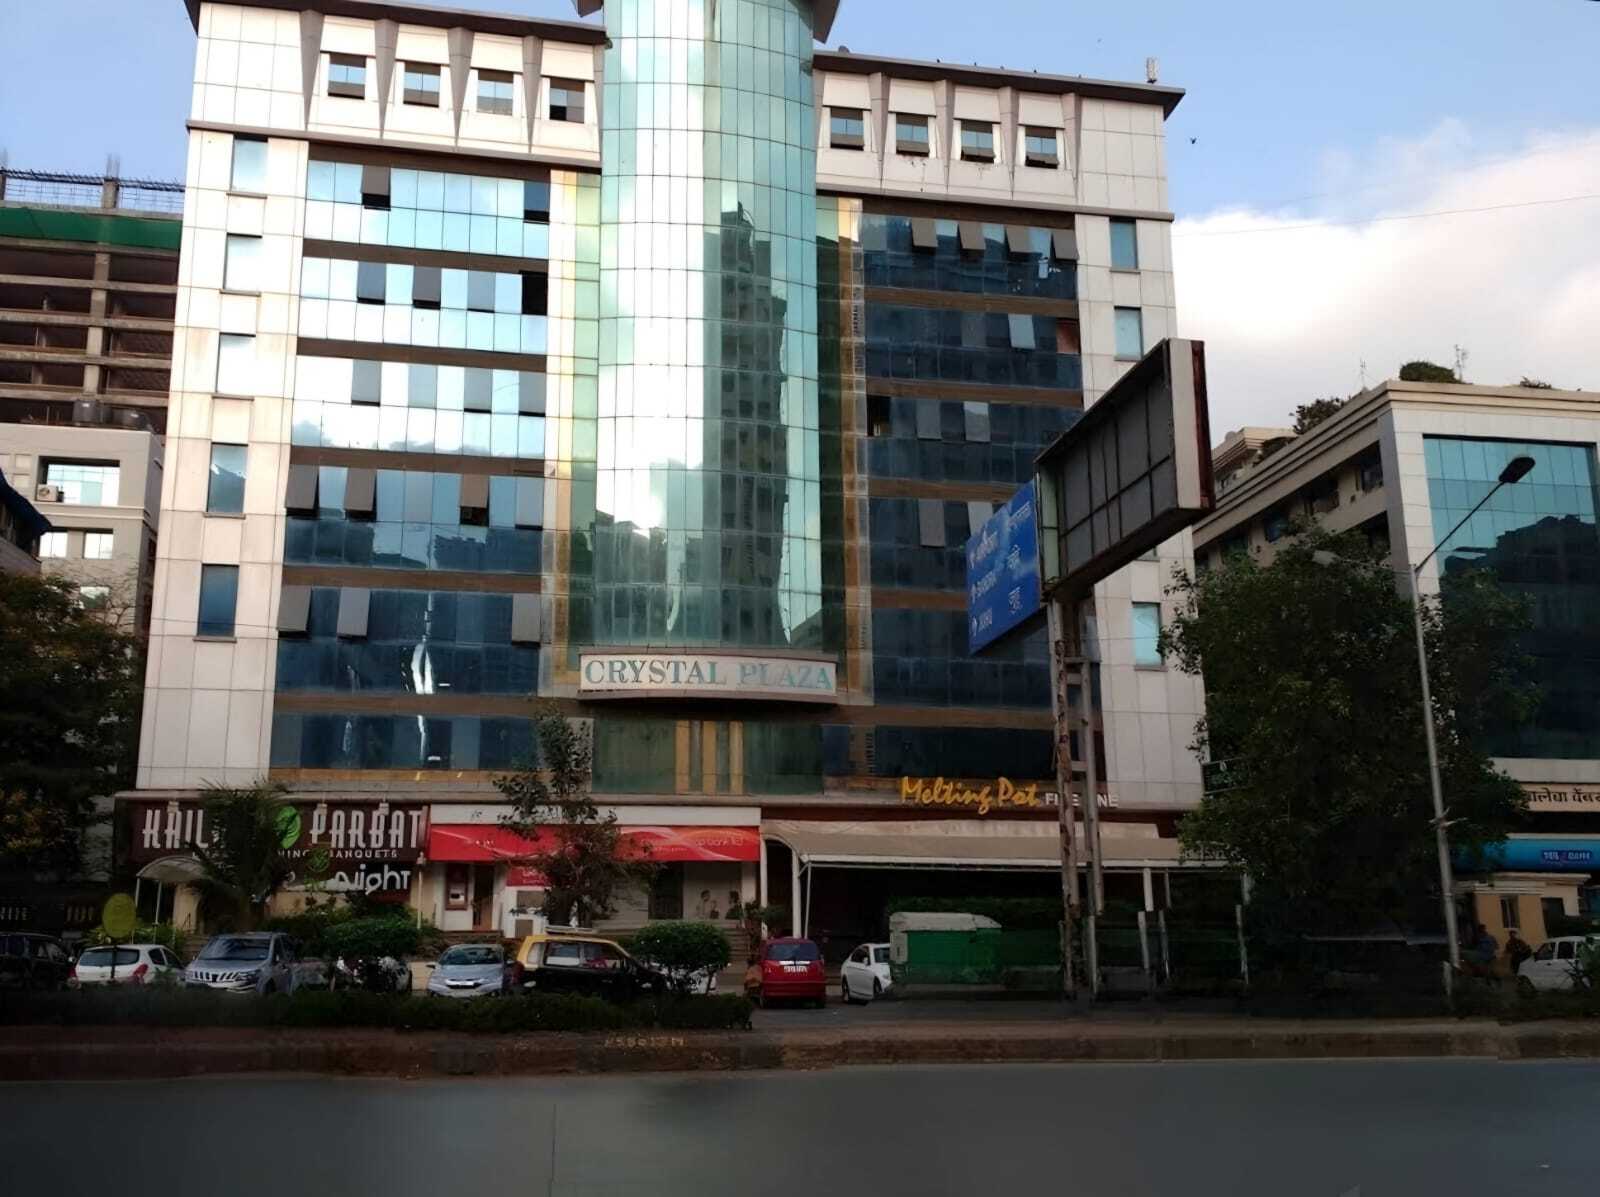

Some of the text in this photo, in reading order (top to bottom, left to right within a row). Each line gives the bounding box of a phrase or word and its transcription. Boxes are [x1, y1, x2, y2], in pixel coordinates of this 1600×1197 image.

[584, 659, 833, 690] CRYSTAL PLAZA
[901, 776, 1040, 814] Melting Pot
[1045, 792, 1081, 808] FIE
[309, 808, 422, 849] PARBAT
